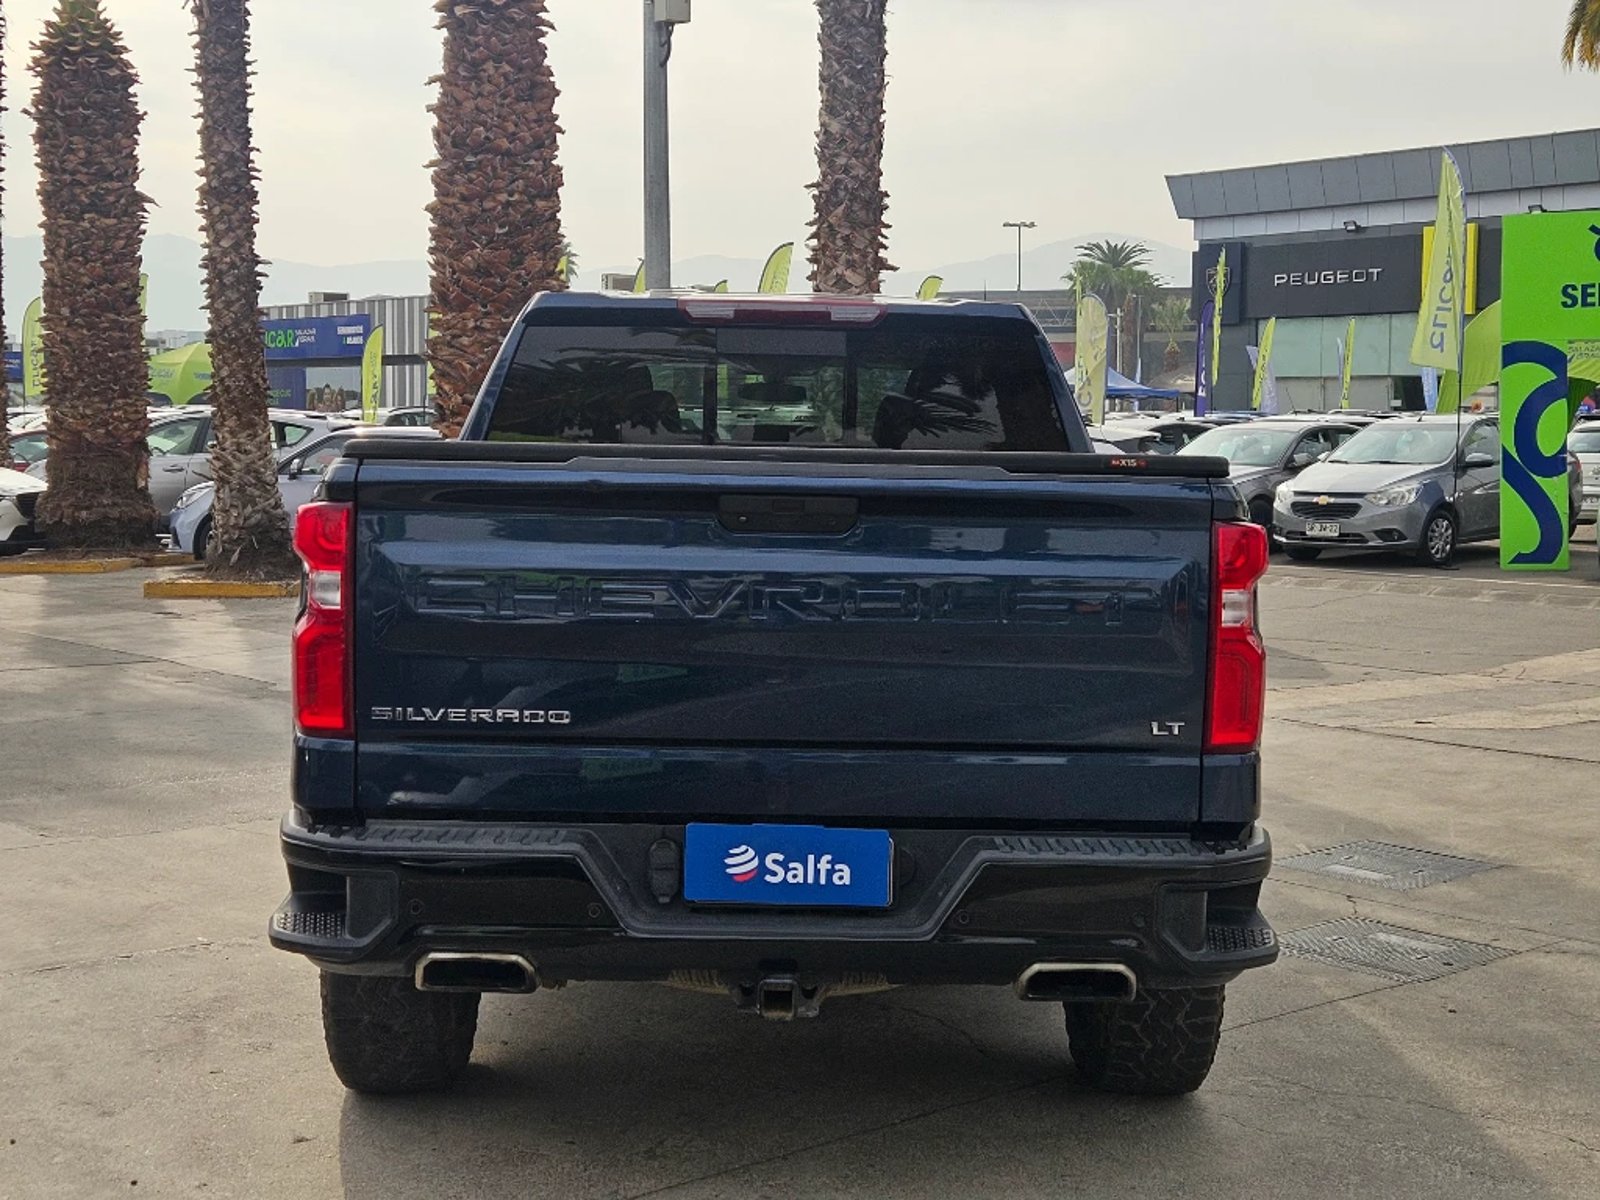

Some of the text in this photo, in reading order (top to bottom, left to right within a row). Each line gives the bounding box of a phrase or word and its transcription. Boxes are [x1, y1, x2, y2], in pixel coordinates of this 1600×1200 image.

[1274, 268, 1382, 286] PEUGEOT
[1561, 283, 1600, 308] SE
[414, 575, 1161, 626] CHEVROLET
[371, 707, 571, 724] SILVERADO
[1151, 721, 1185, 735] LT
[763, 852, 851, 885] Salfa
